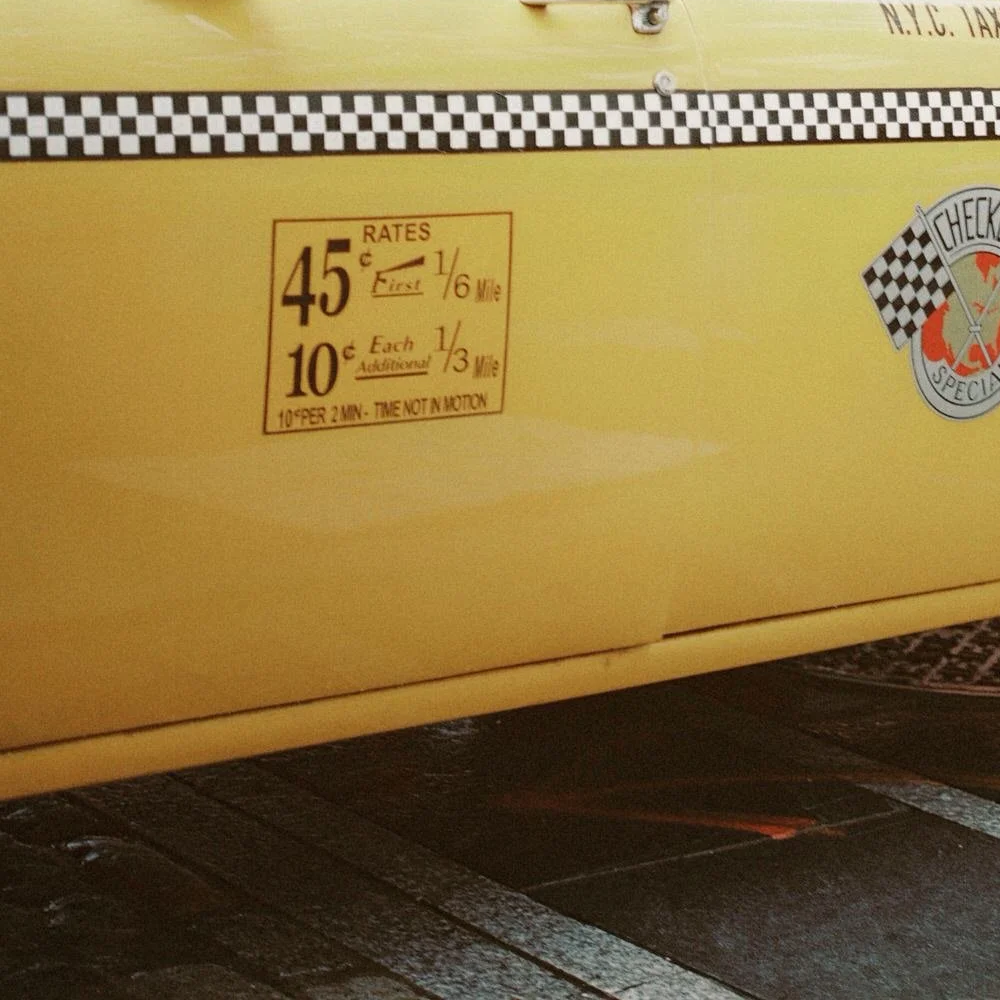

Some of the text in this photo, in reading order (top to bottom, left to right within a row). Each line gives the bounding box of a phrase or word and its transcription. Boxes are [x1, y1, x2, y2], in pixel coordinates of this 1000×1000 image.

[879, 2, 955, 38] N.Y.C.
[362, 221, 431, 243] RATES
[474, 278, 501, 302] Mile
[369, 334, 414, 355] Each
[354, 354, 432, 375] Additional
[472, 353, 499, 379] Mile
[374, 398, 402, 418] TIME
[403, 398, 428, 416] NOT
[441, 391, 488, 412] MOTION
